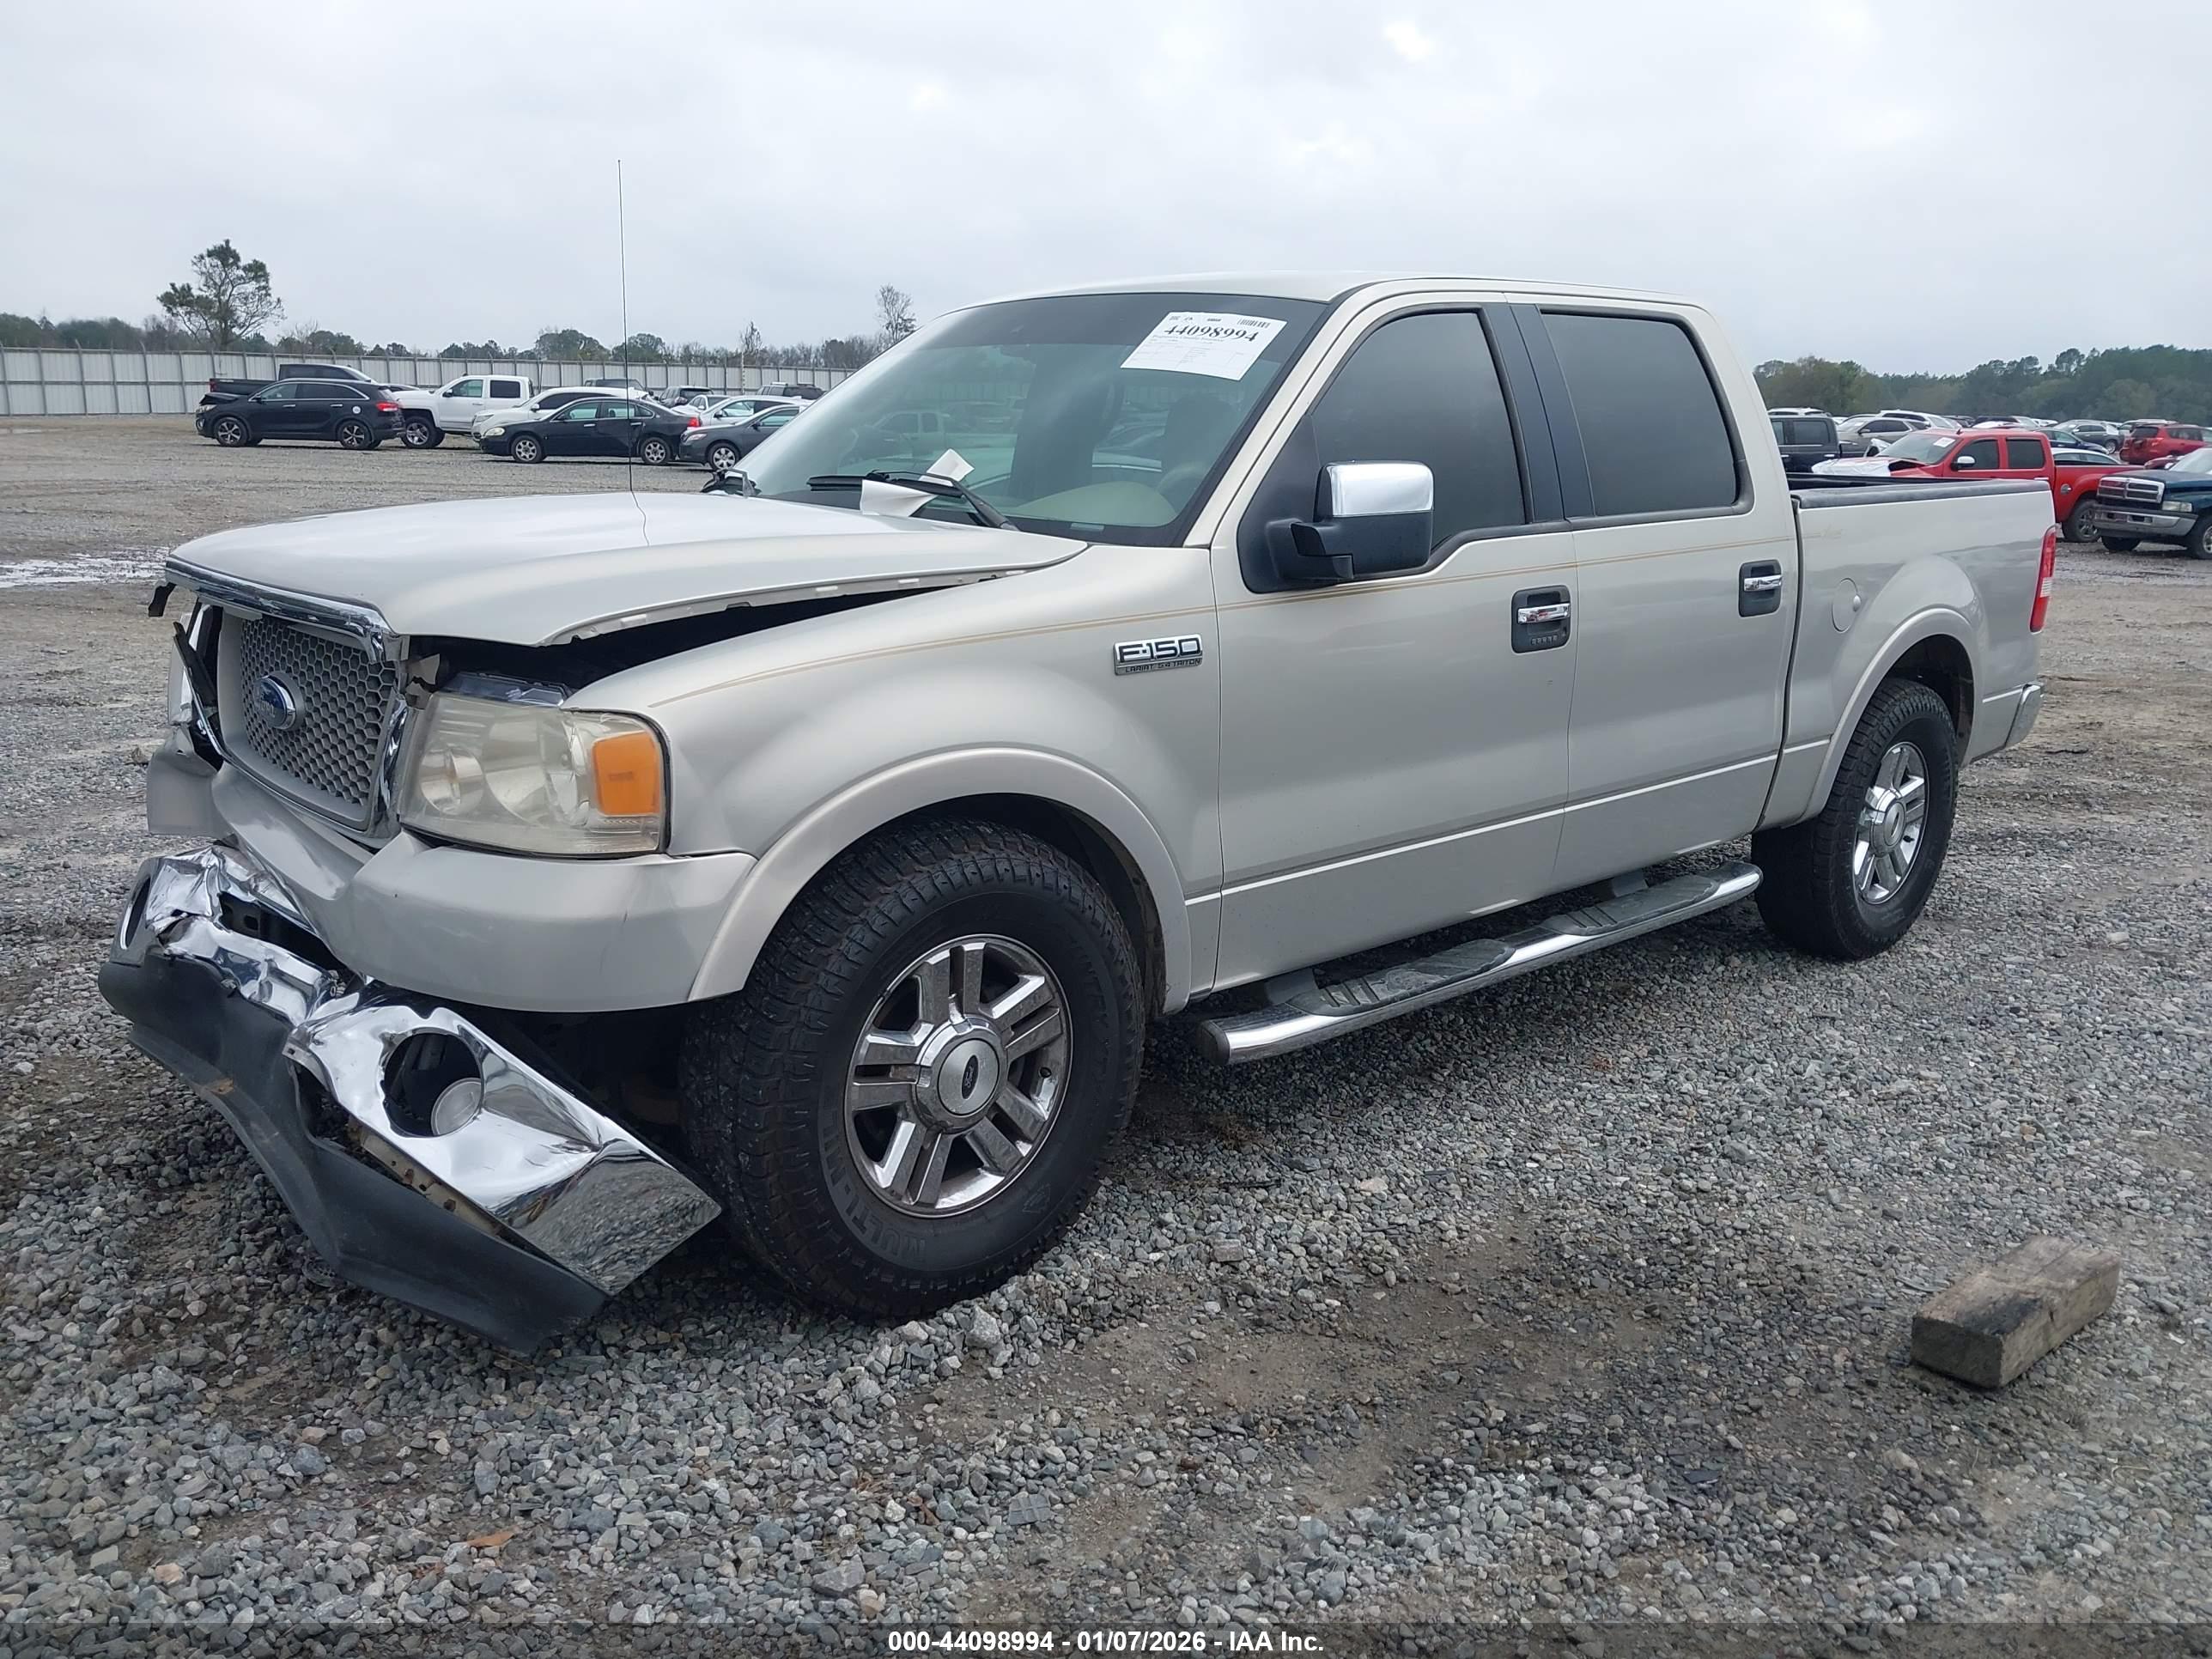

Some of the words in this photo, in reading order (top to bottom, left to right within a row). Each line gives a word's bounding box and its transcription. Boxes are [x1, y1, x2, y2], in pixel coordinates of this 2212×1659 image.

[1164, 325, 1259, 342] 44098994
[1125, 664, 1155, 673] LARIAT
[1172, 658, 1201, 668] TRITON
